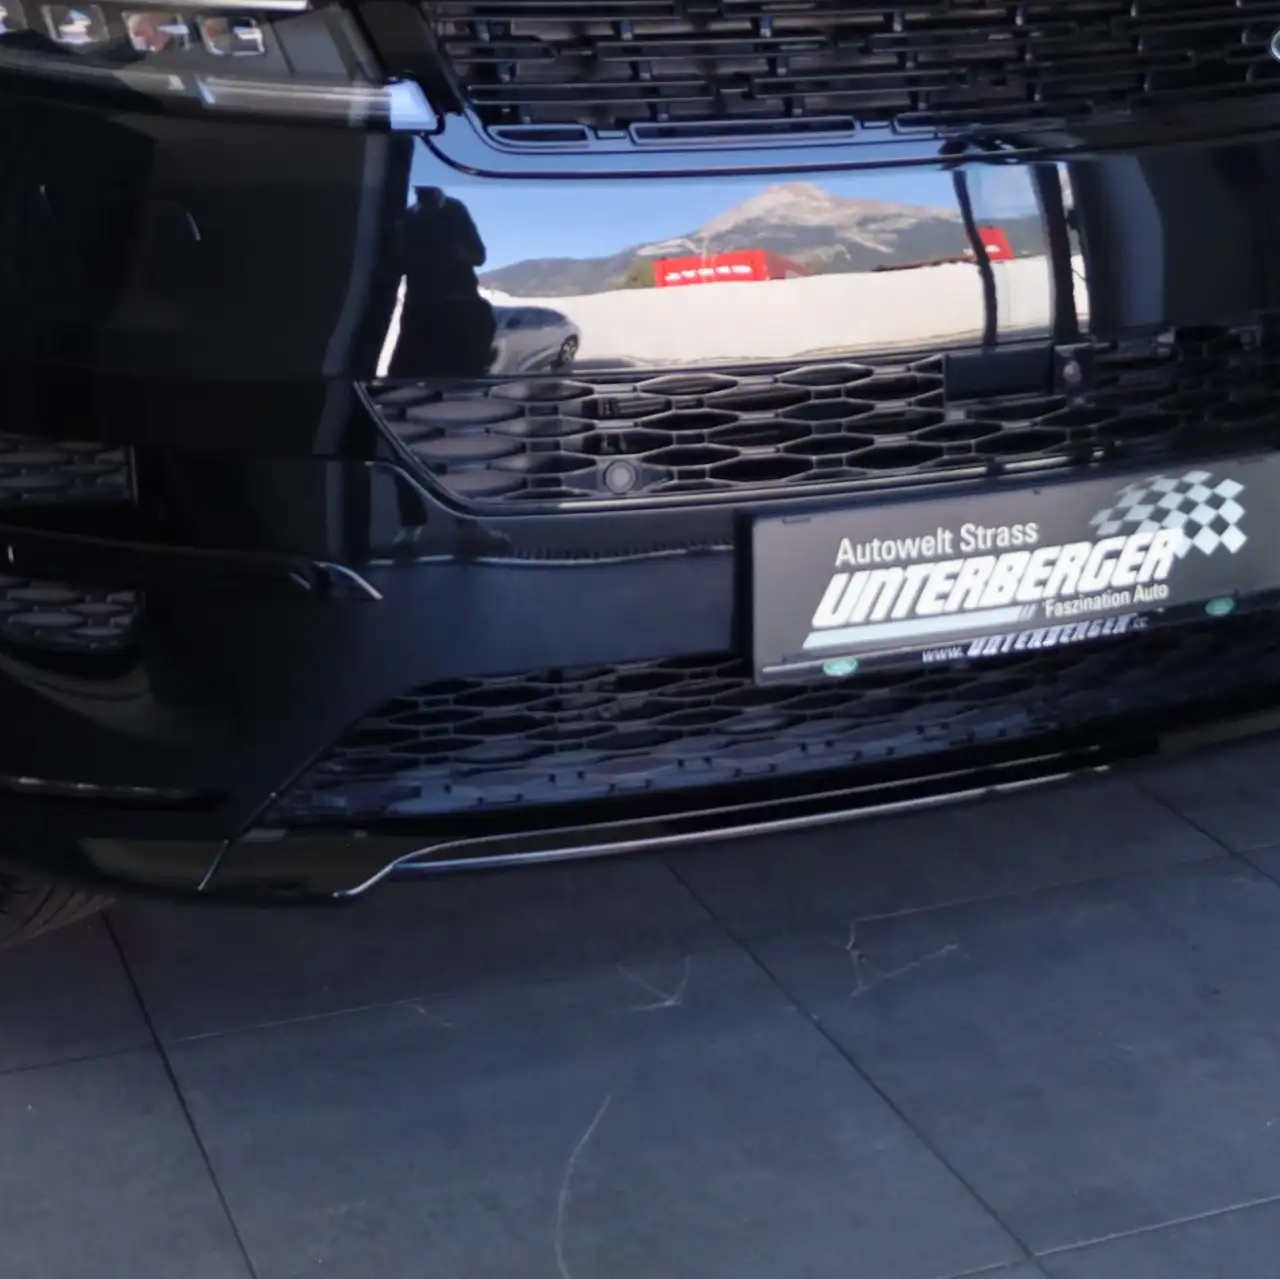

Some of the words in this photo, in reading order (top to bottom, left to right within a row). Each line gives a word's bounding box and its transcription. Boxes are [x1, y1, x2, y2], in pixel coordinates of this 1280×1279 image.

[835, 527, 953, 567] Autowelt
[959, 522, 1039, 552] Strass
[811, 528, 1183, 628] UNTERBERGER
[1044, 591, 1130, 618] Faszination
[1132, 582, 1169, 603] Auto
